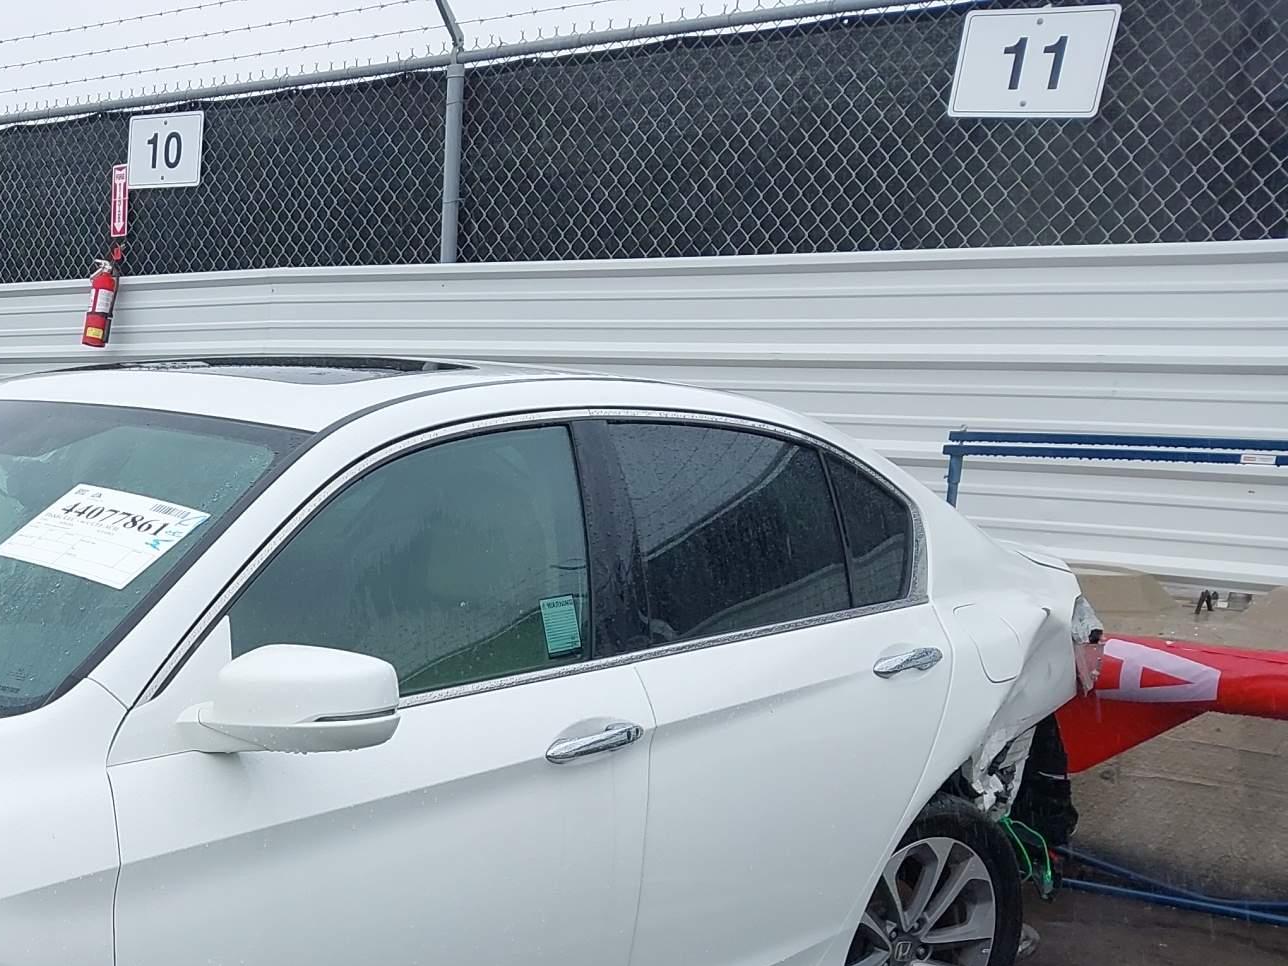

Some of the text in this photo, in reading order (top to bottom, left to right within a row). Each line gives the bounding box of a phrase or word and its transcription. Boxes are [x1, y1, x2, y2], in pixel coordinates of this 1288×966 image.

[1003, 36, 1068, 90] 11
[147, 131, 183, 169] 10
[61, 502, 171, 536] 44077861
